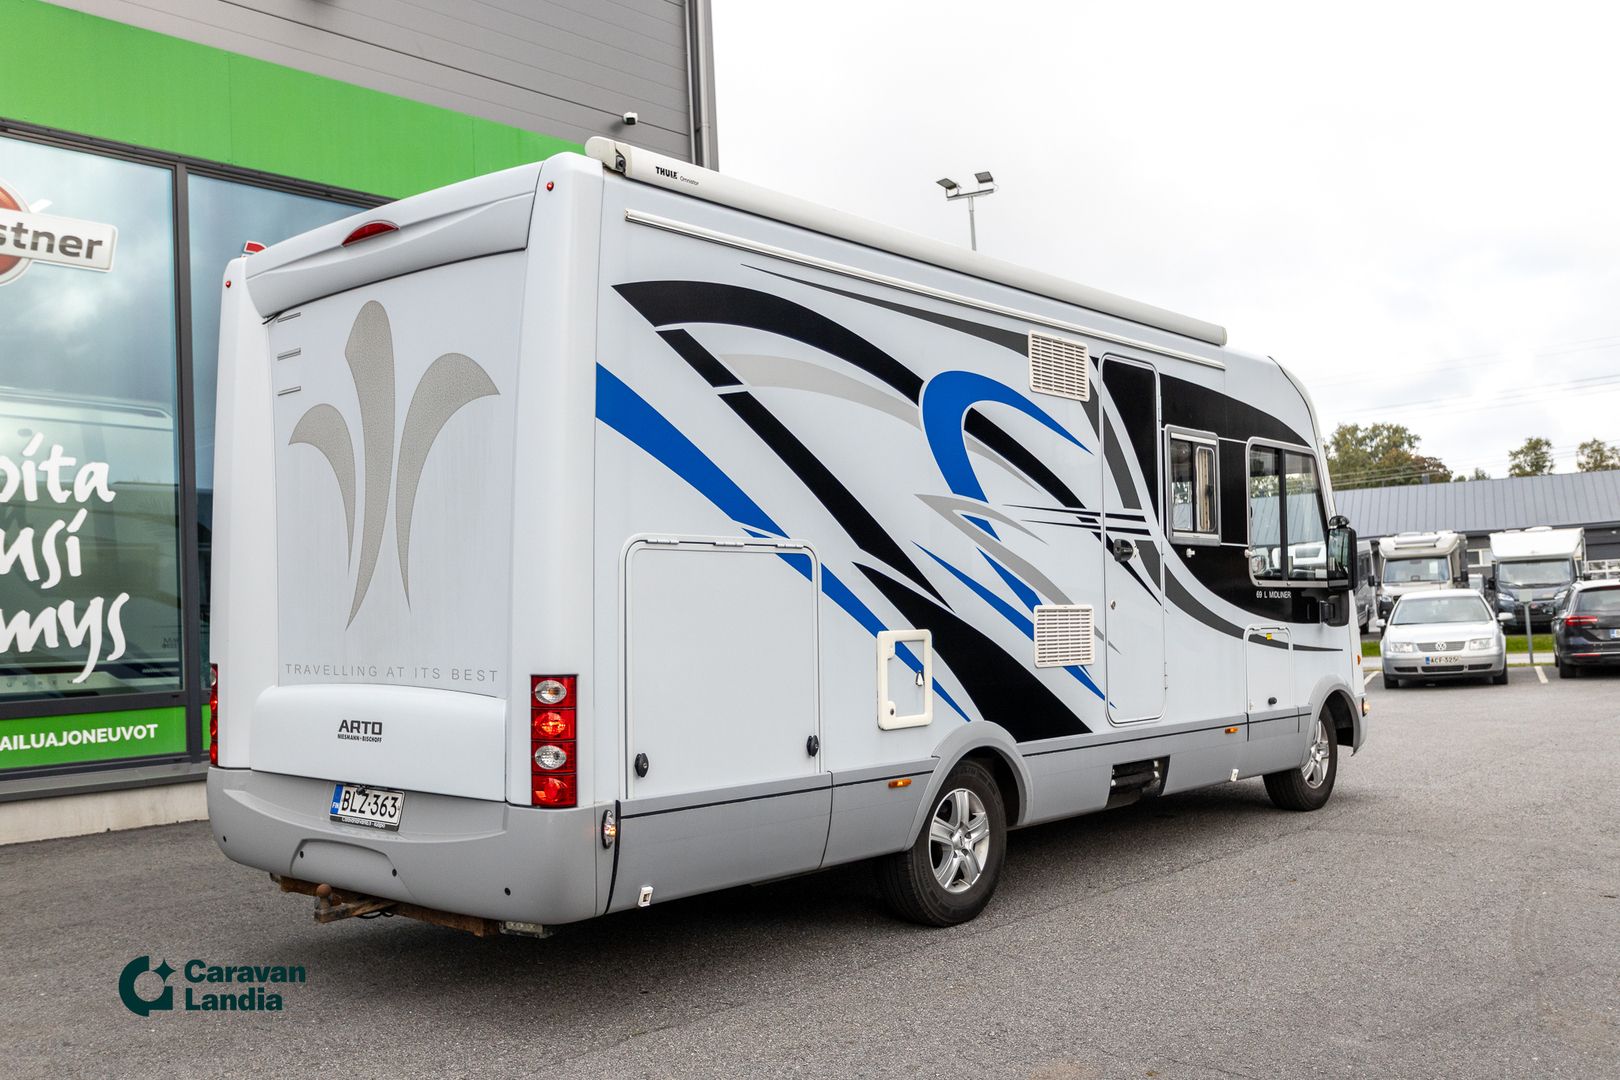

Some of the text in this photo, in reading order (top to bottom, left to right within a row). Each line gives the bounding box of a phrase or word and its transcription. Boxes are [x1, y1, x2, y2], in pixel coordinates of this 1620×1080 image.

[655, 166, 678, 179] THULE
[1264, 590, 1269, 599] L
[285, 663, 499, 683] TRAVELLING AT ITS BEST
[338, 719, 383, 736] ARTO
[0, 724, 158, 751] AILUAJONEUVOT
[341, 790, 399, 818] BLZ-363
